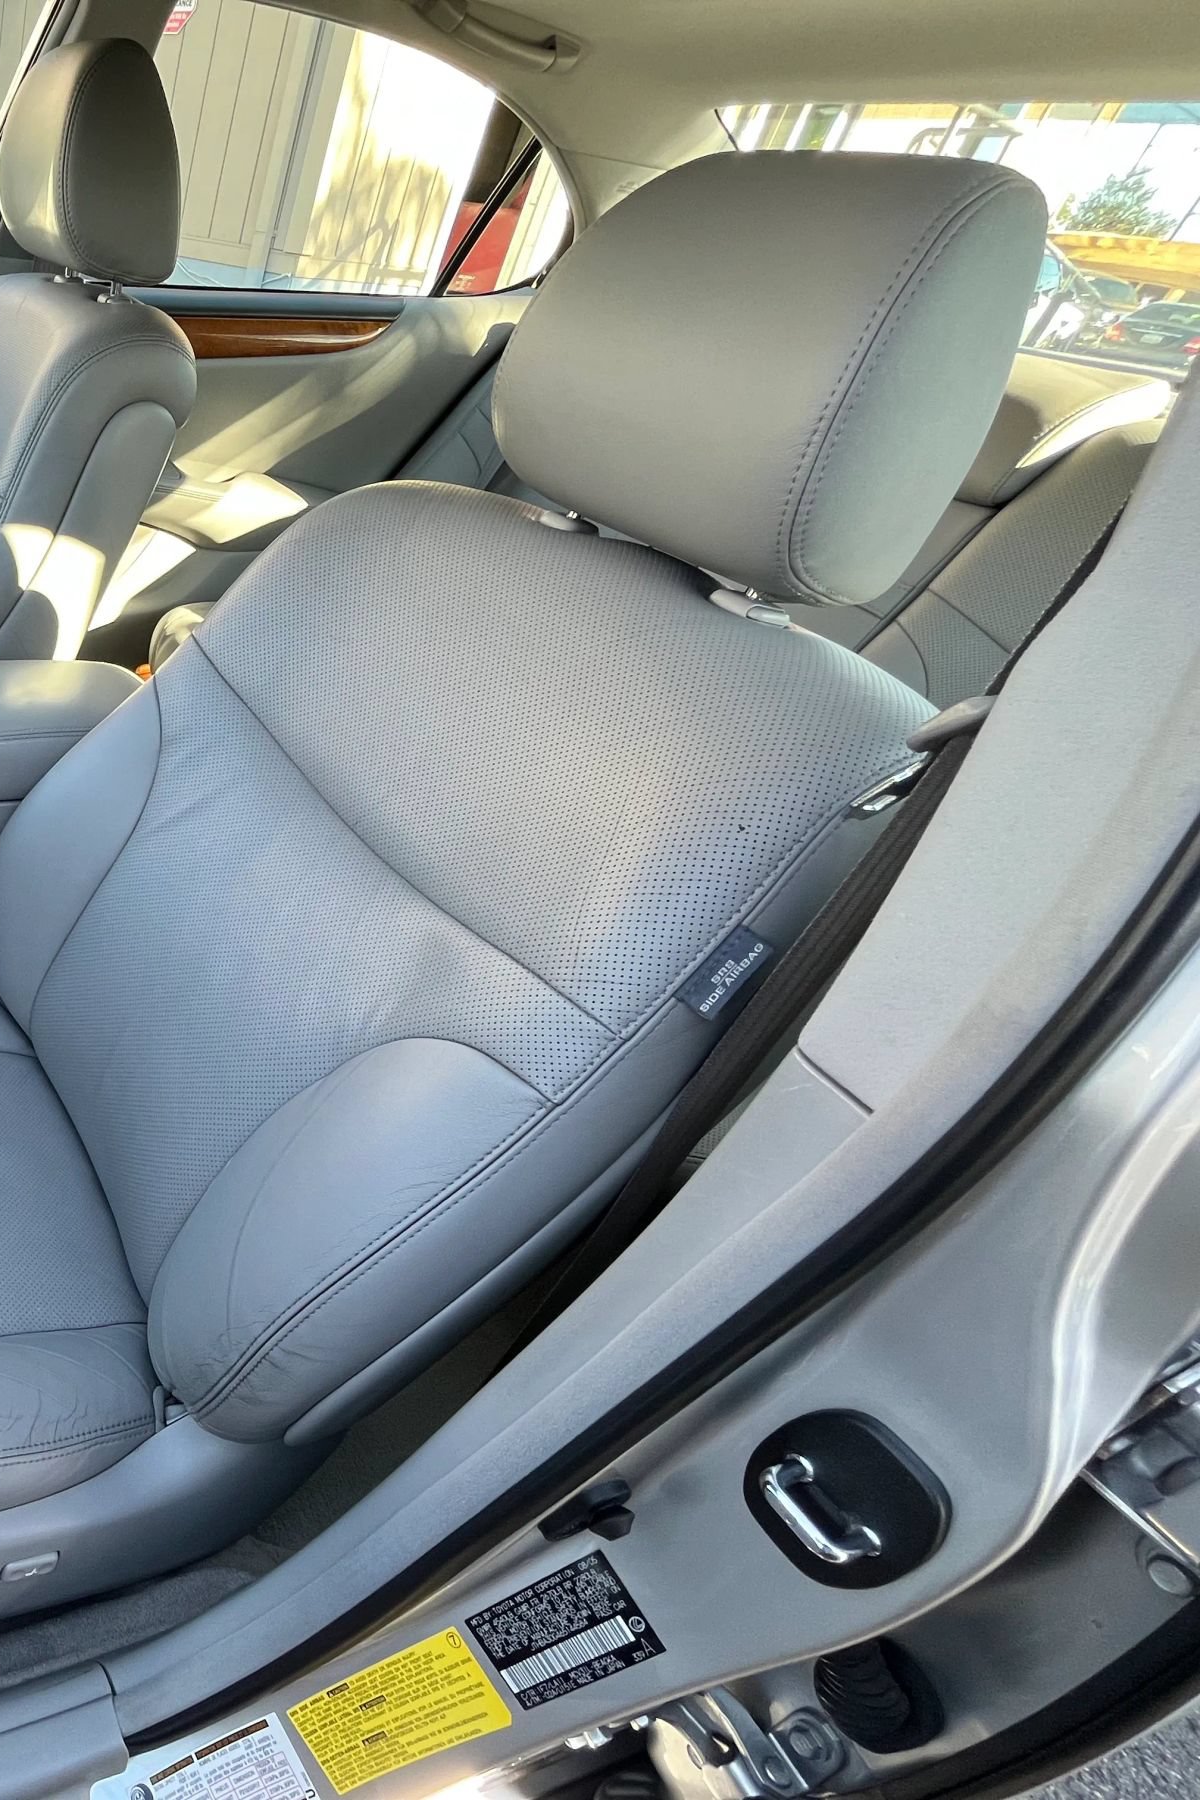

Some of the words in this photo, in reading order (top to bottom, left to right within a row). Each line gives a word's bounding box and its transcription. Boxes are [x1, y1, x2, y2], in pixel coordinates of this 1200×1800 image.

[699, 984, 727, 1013] SIDE
[725, 942, 764, 987] AIRBAG
[711, 959, 737, 985] SRS
[513, 1588, 534, 1603] MOTOR
[533, 1567, 575, 1593] CORPORATION
